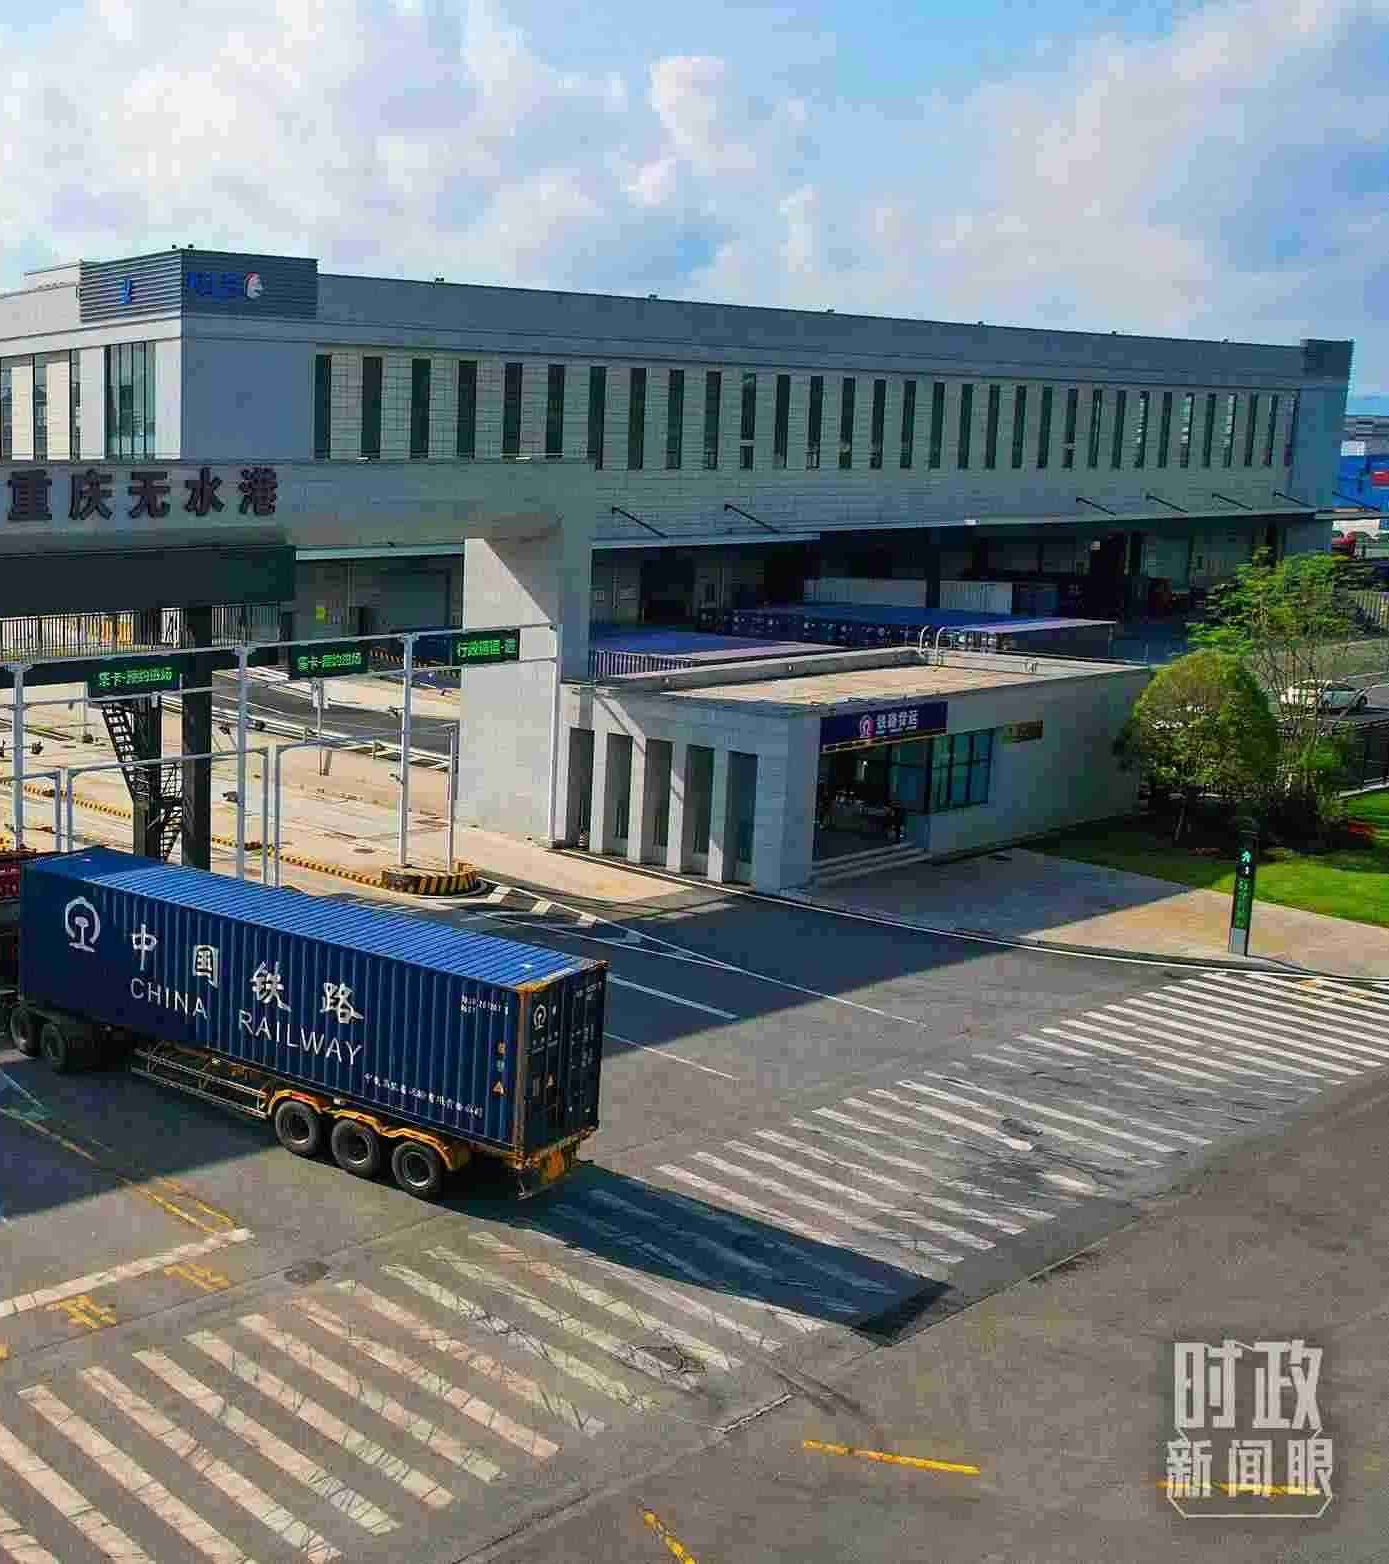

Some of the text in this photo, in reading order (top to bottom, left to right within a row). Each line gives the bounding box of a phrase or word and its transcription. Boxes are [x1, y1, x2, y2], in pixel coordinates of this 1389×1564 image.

[130, 923, 364, 1025] 中国铁路
[130, 976, 364, 1066] CHINA RAILWAY
